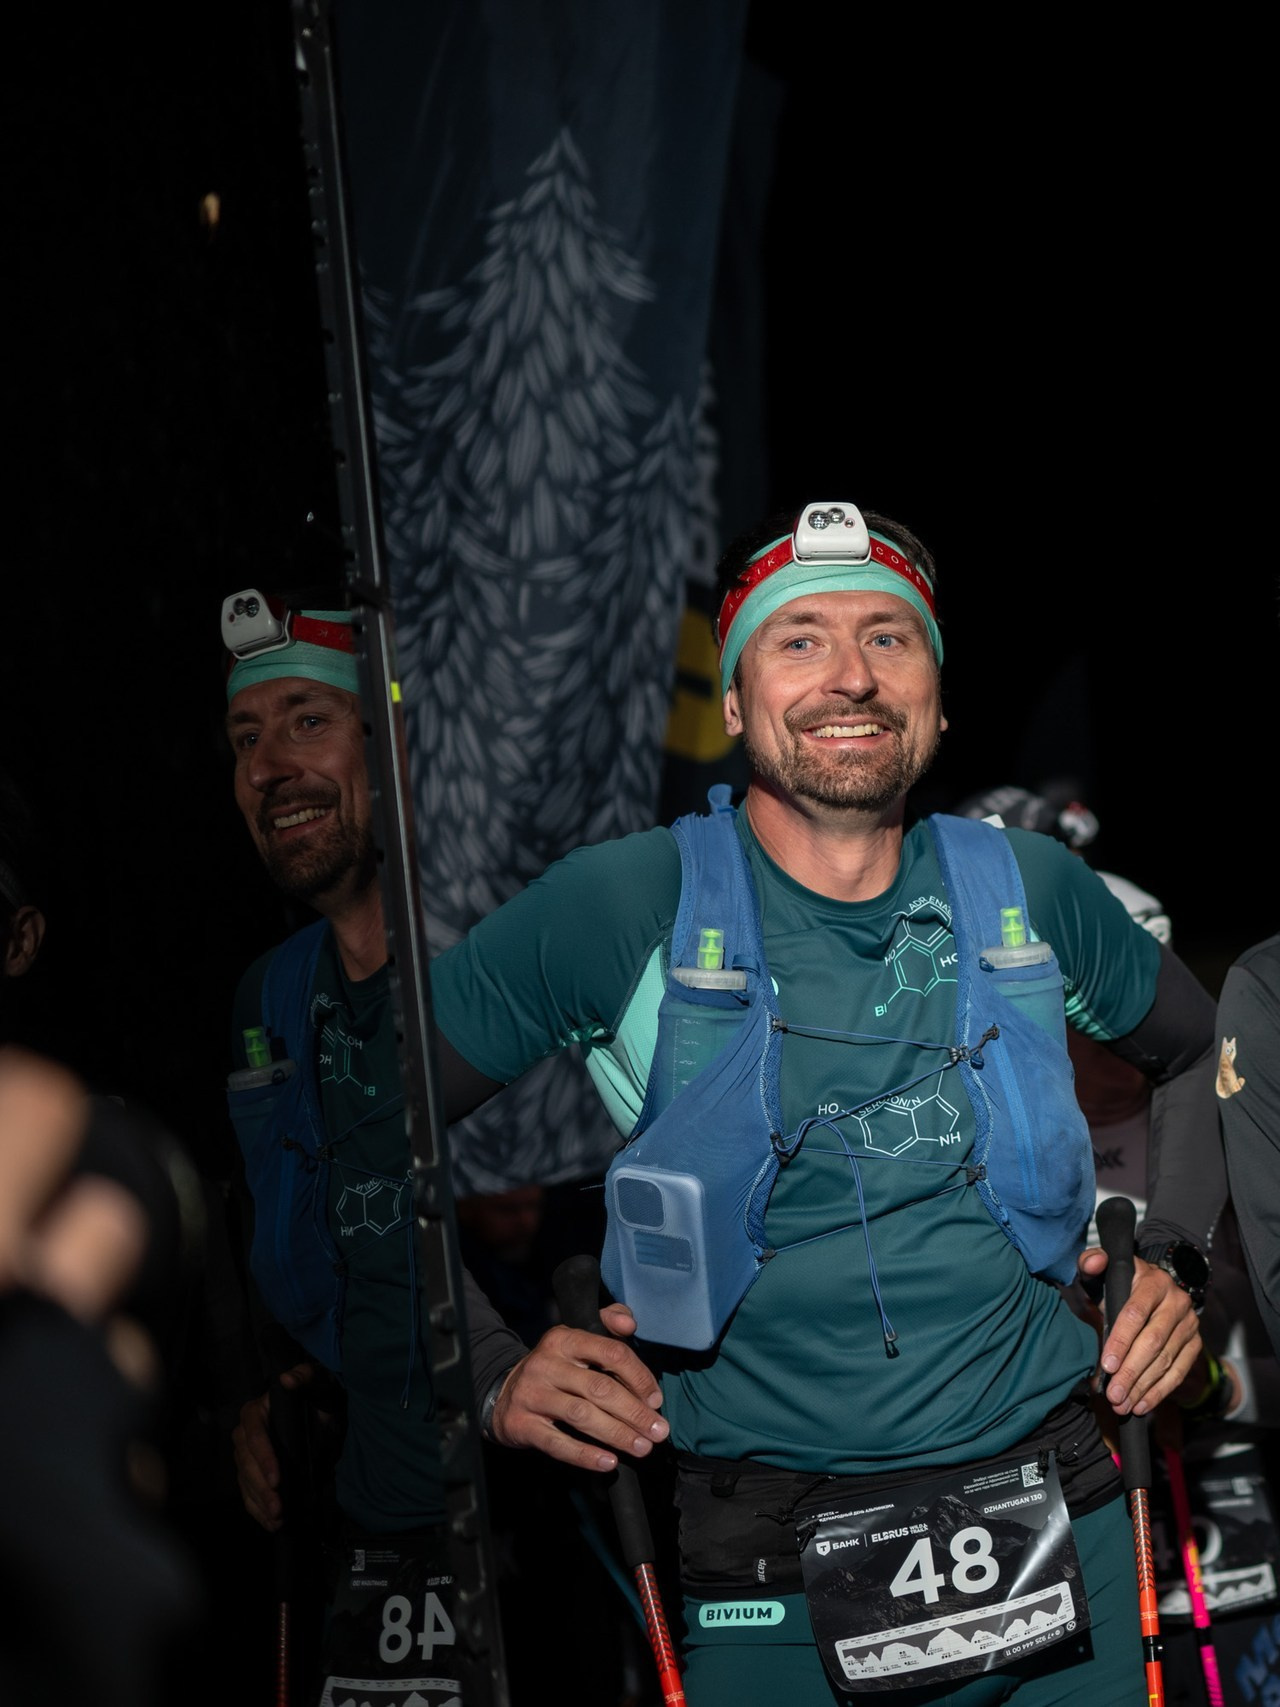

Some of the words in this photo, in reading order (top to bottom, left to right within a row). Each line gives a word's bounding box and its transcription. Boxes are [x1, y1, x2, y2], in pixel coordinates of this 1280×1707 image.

[875, 546, 922, 586] CORE
[884, 949, 896, 967] HO
[817, 1102, 839, 1116] HO
[938, 1131, 962, 1147] NH
[983, 1496, 1030, 1514] DZHANTUGAN
[1030, 1493, 1043, 1502] 130
[871, 1527, 910, 1543] ELBRUS
[832, 1538, 861, 1550] БАНК
[889, 1526, 1000, 1605] 48
[706, 1607, 772, 1621] BIVIUM
[1022, 1641, 1034, 1650] 444
[1035, 1636, 1047, 1645] 925
